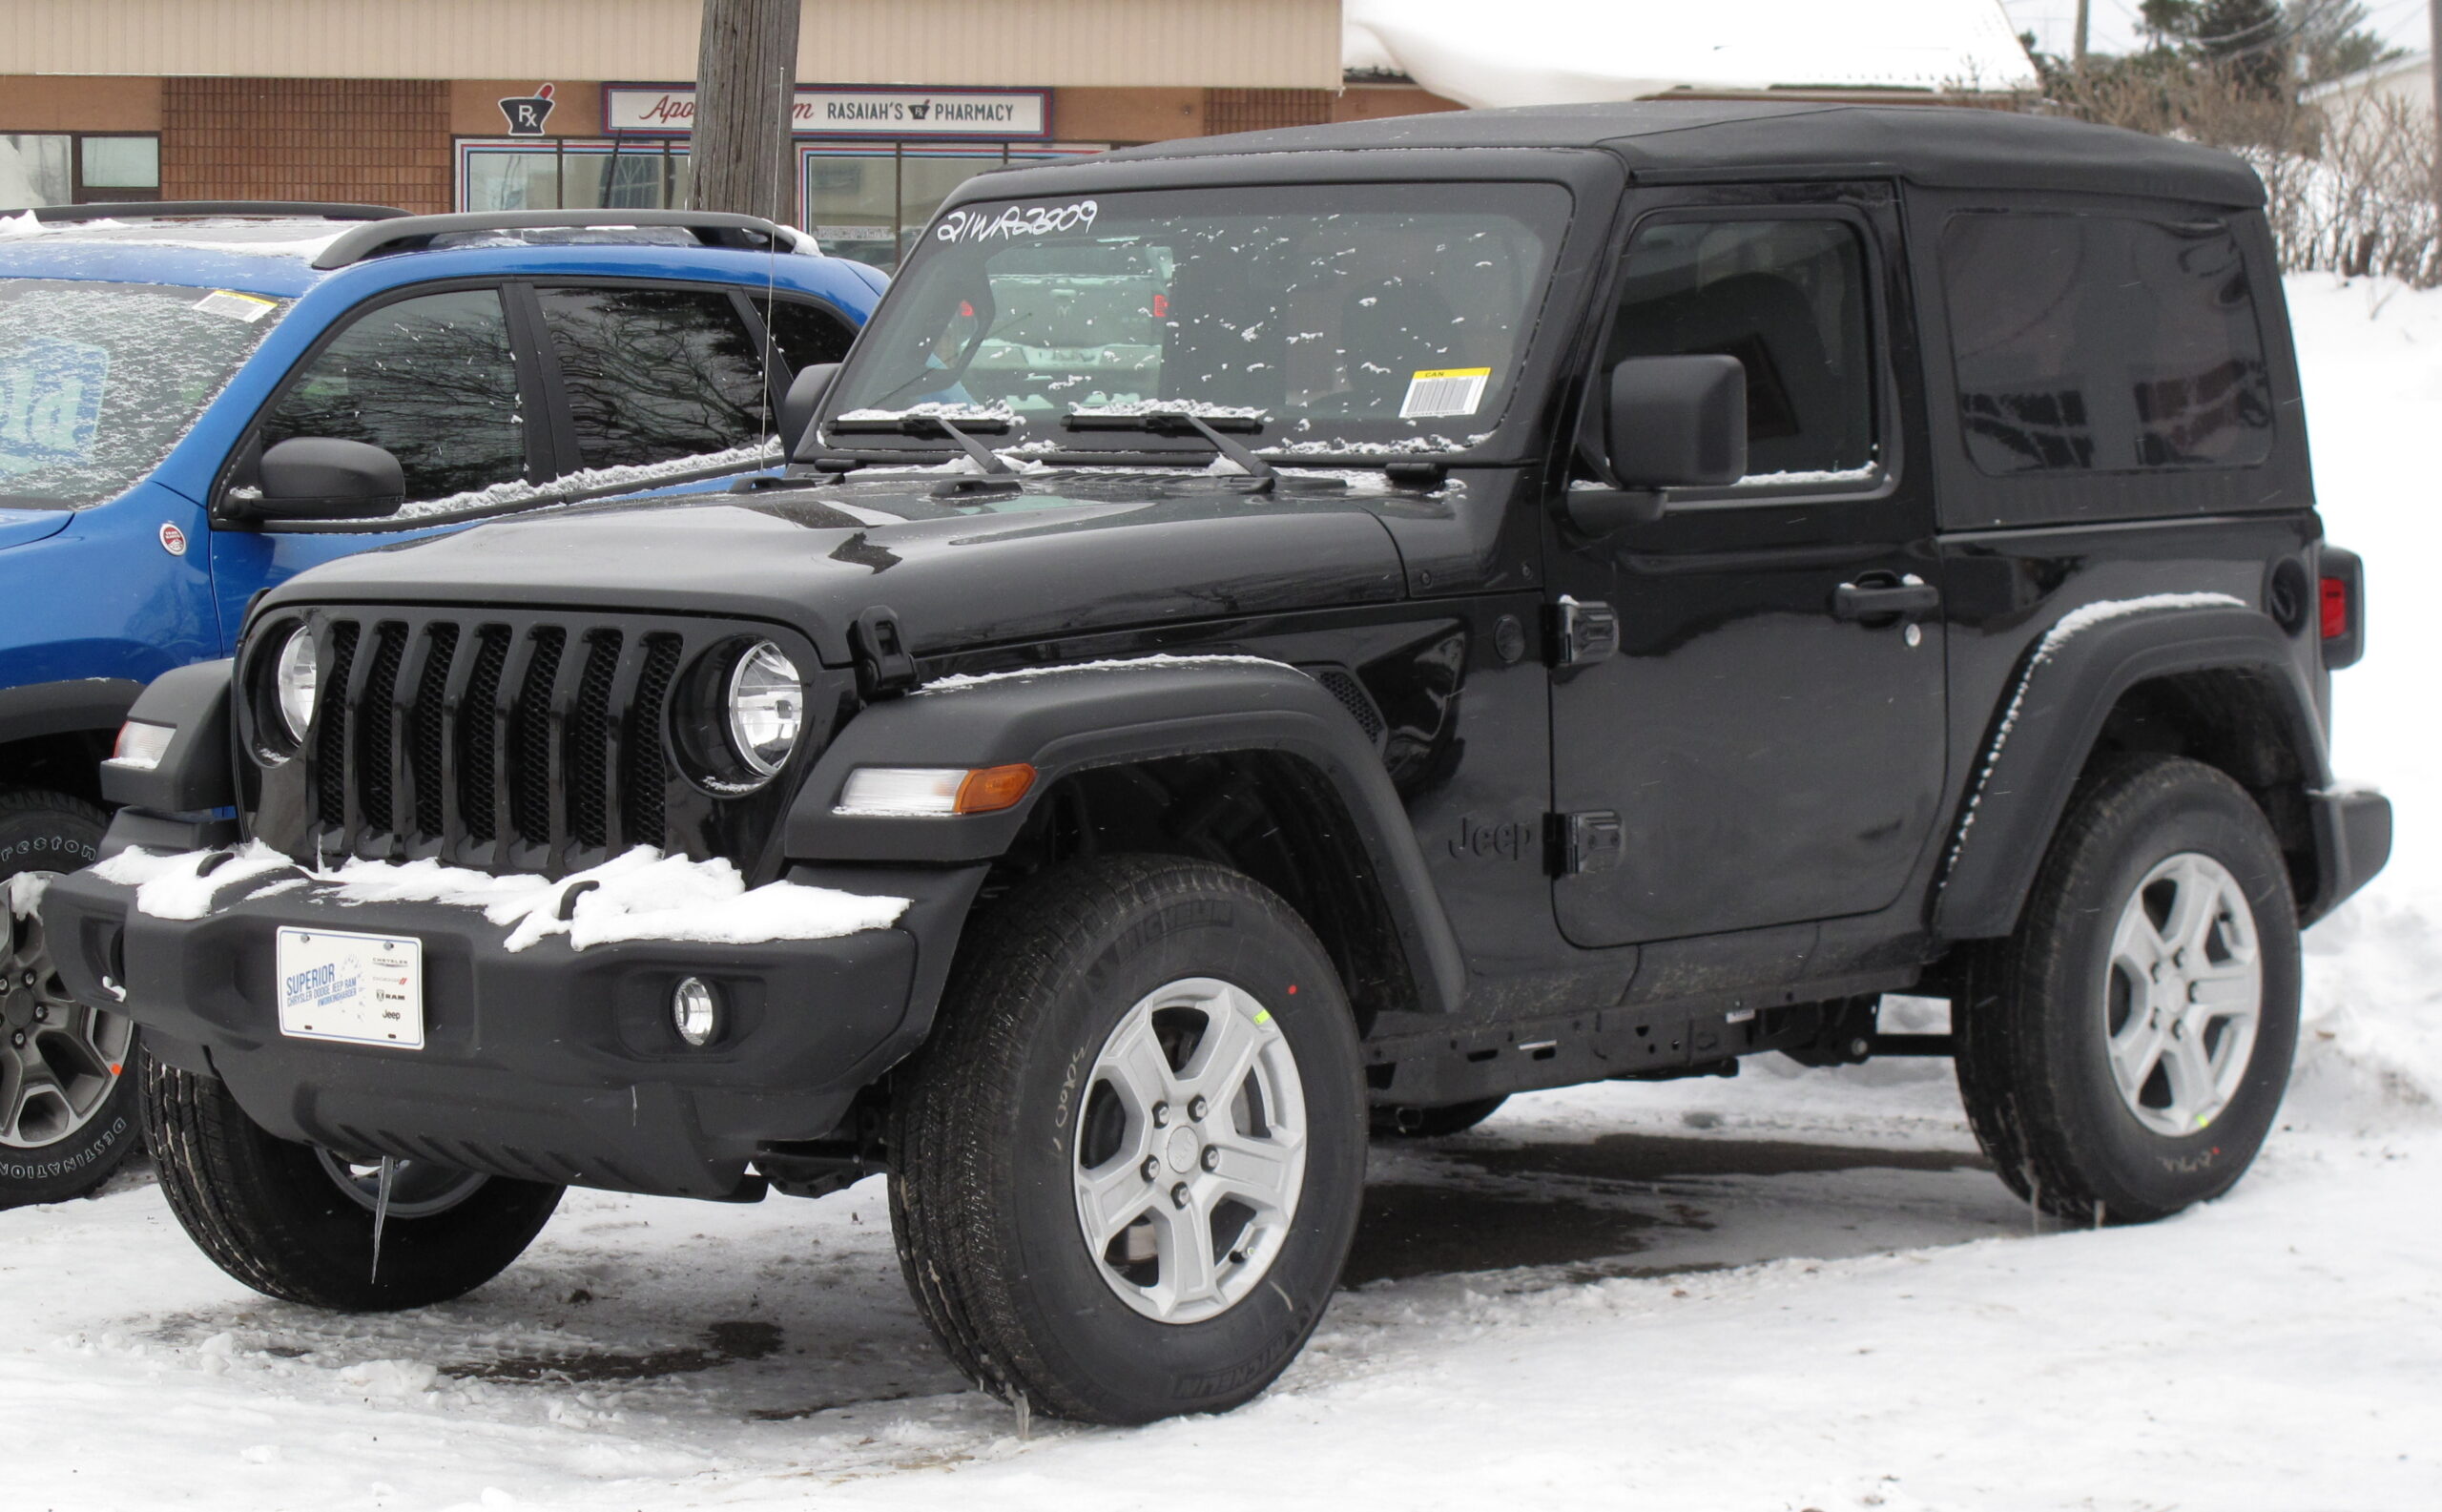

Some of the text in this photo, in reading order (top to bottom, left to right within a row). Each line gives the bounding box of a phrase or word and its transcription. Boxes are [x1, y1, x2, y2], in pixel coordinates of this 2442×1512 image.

[639, 94, 695, 124] Apo
[827, 101, 903, 120] RASAIAH'S
[935, 102, 1014, 122] PHARMACY
[0, 837, 96, 861] reston
[1448, 817, 1532, 861] Jeep
[286, 963, 335, 996] SUPERIOR
[382, 1008, 401, 1022] Jeep
